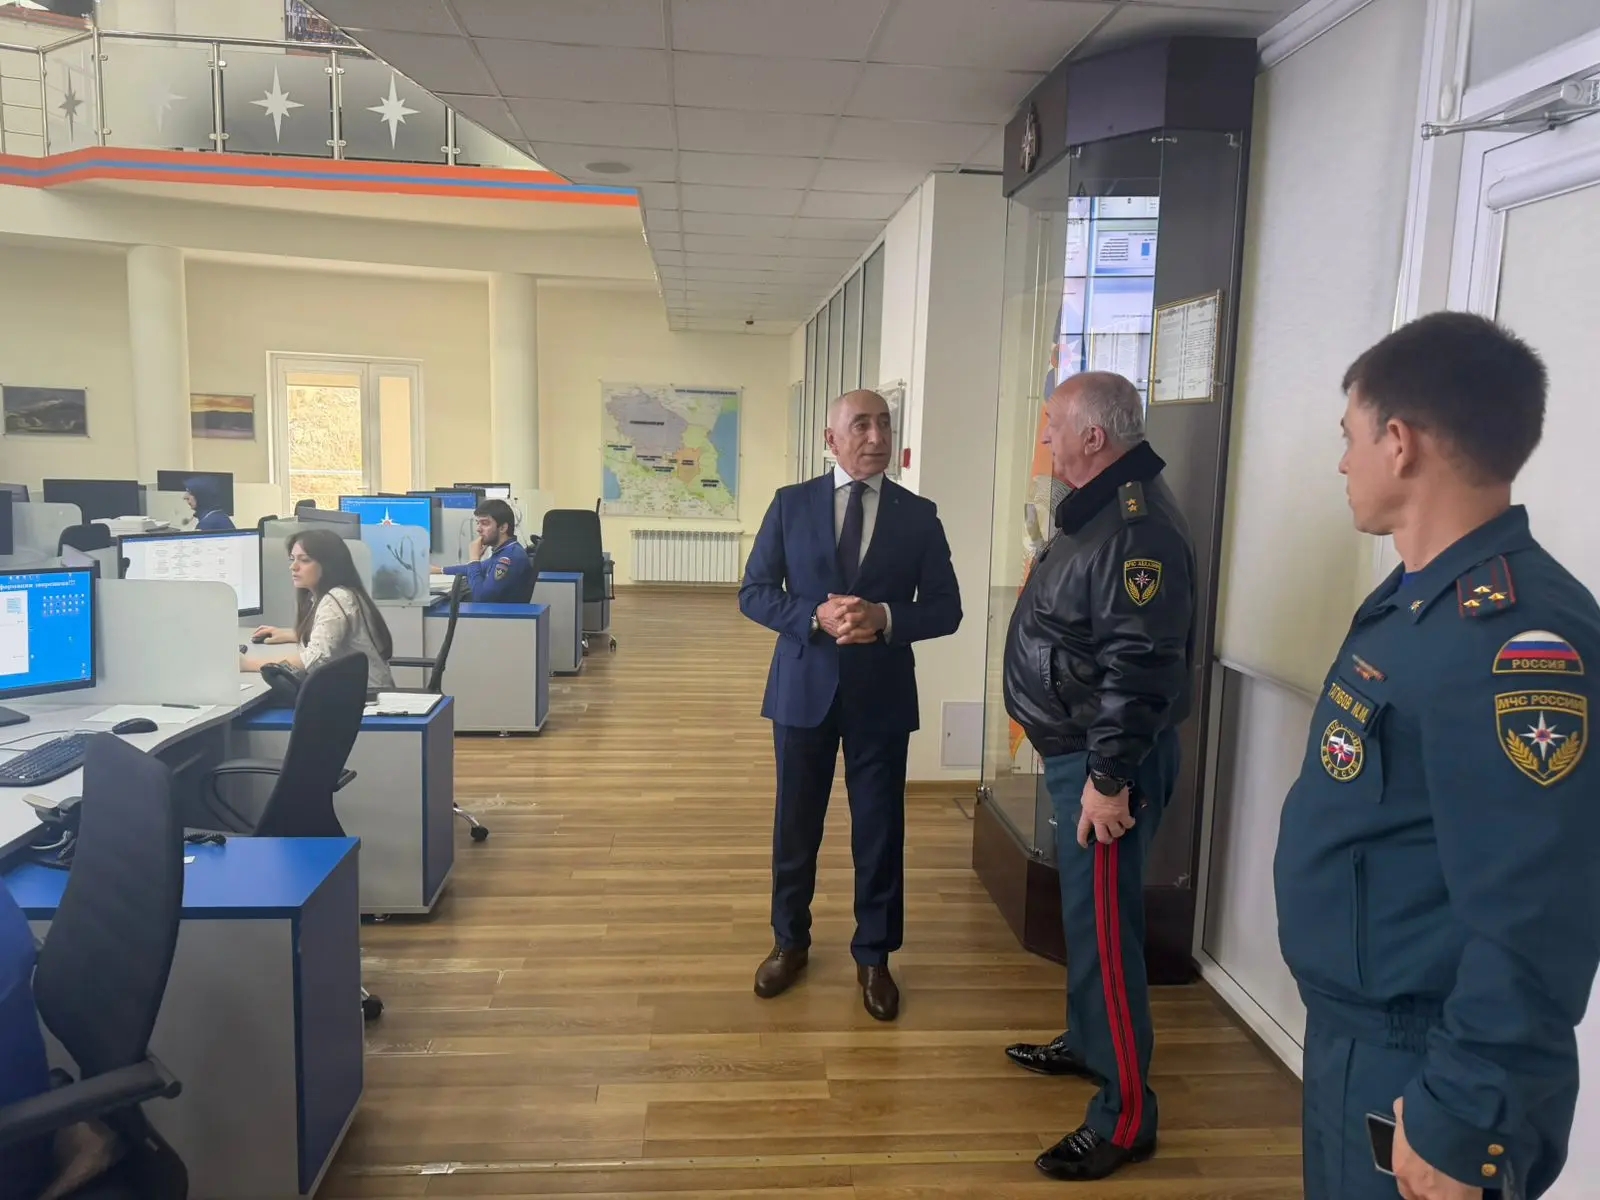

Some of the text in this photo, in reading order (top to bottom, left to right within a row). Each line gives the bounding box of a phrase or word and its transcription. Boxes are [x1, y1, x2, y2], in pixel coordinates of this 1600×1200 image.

[1512, 659, 1566, 670] РОССИЯ
[1498, 695, 1585, 711] МЧС РОССИИ
